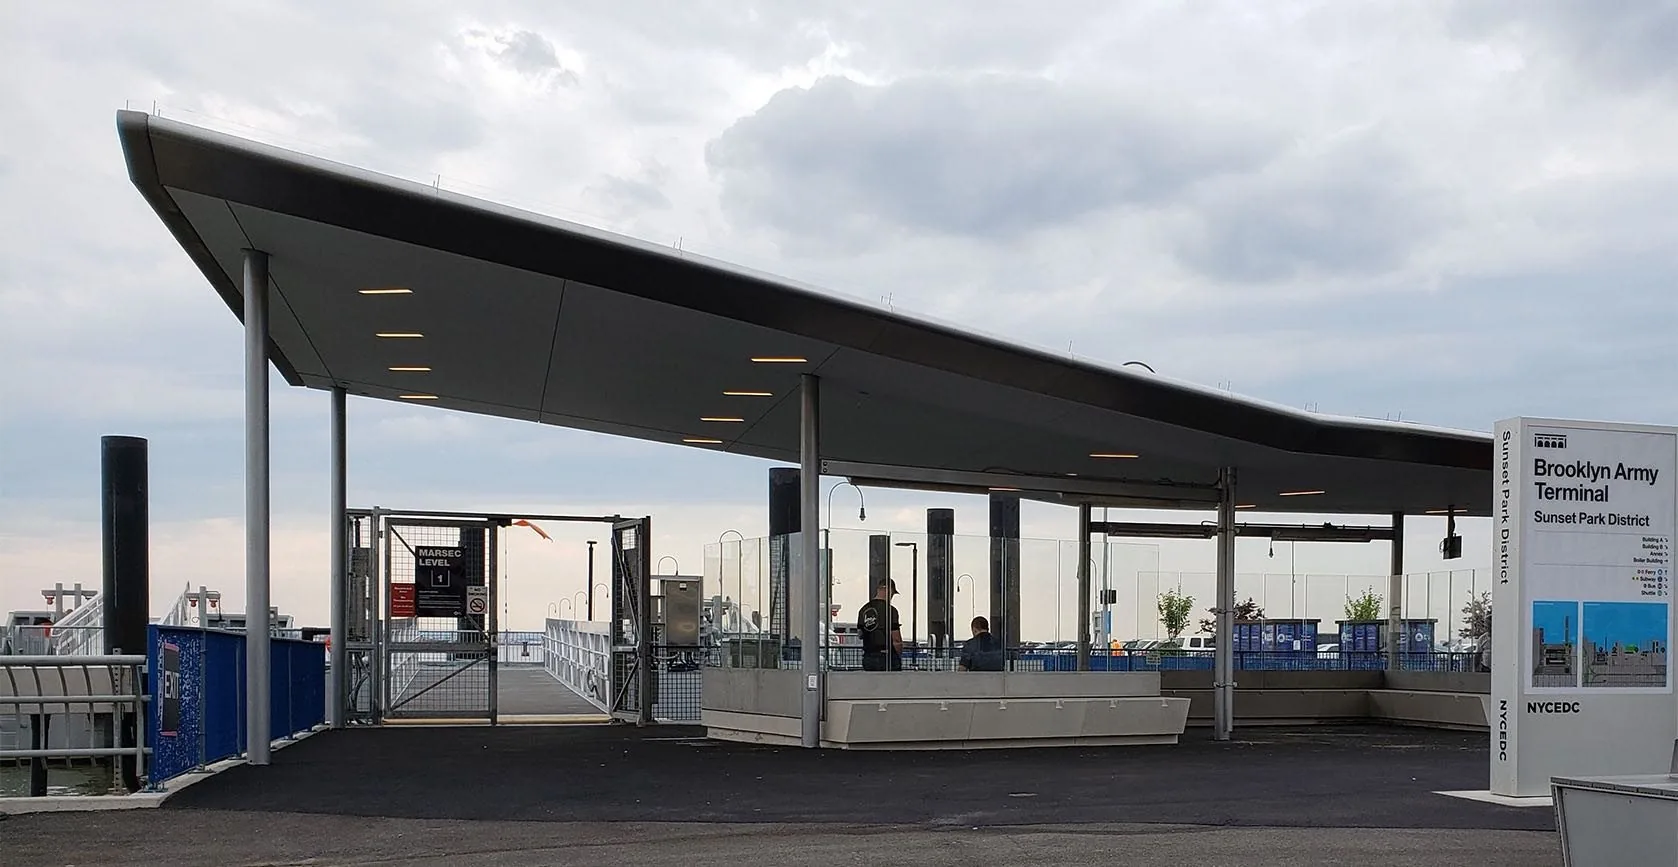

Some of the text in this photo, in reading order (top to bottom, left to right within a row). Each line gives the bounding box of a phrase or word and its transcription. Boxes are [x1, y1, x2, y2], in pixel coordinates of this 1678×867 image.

[1534, 458, 1659, 486] Brooklyn Army
[1534, 482, 1609, 502] Terminal
[1500, 431, 1511, 585] Sunset Park District
[1534, 510, 1650, 527] Sunset Park District
[419, 549, 461, 558] MARSEC
[419, 558, 450, 566] LEVEL
[437, 574, 443, 583] 1
[165, 670, 179, 699] EXIT
[1527, 702, 1580, 714] NYCEDC
